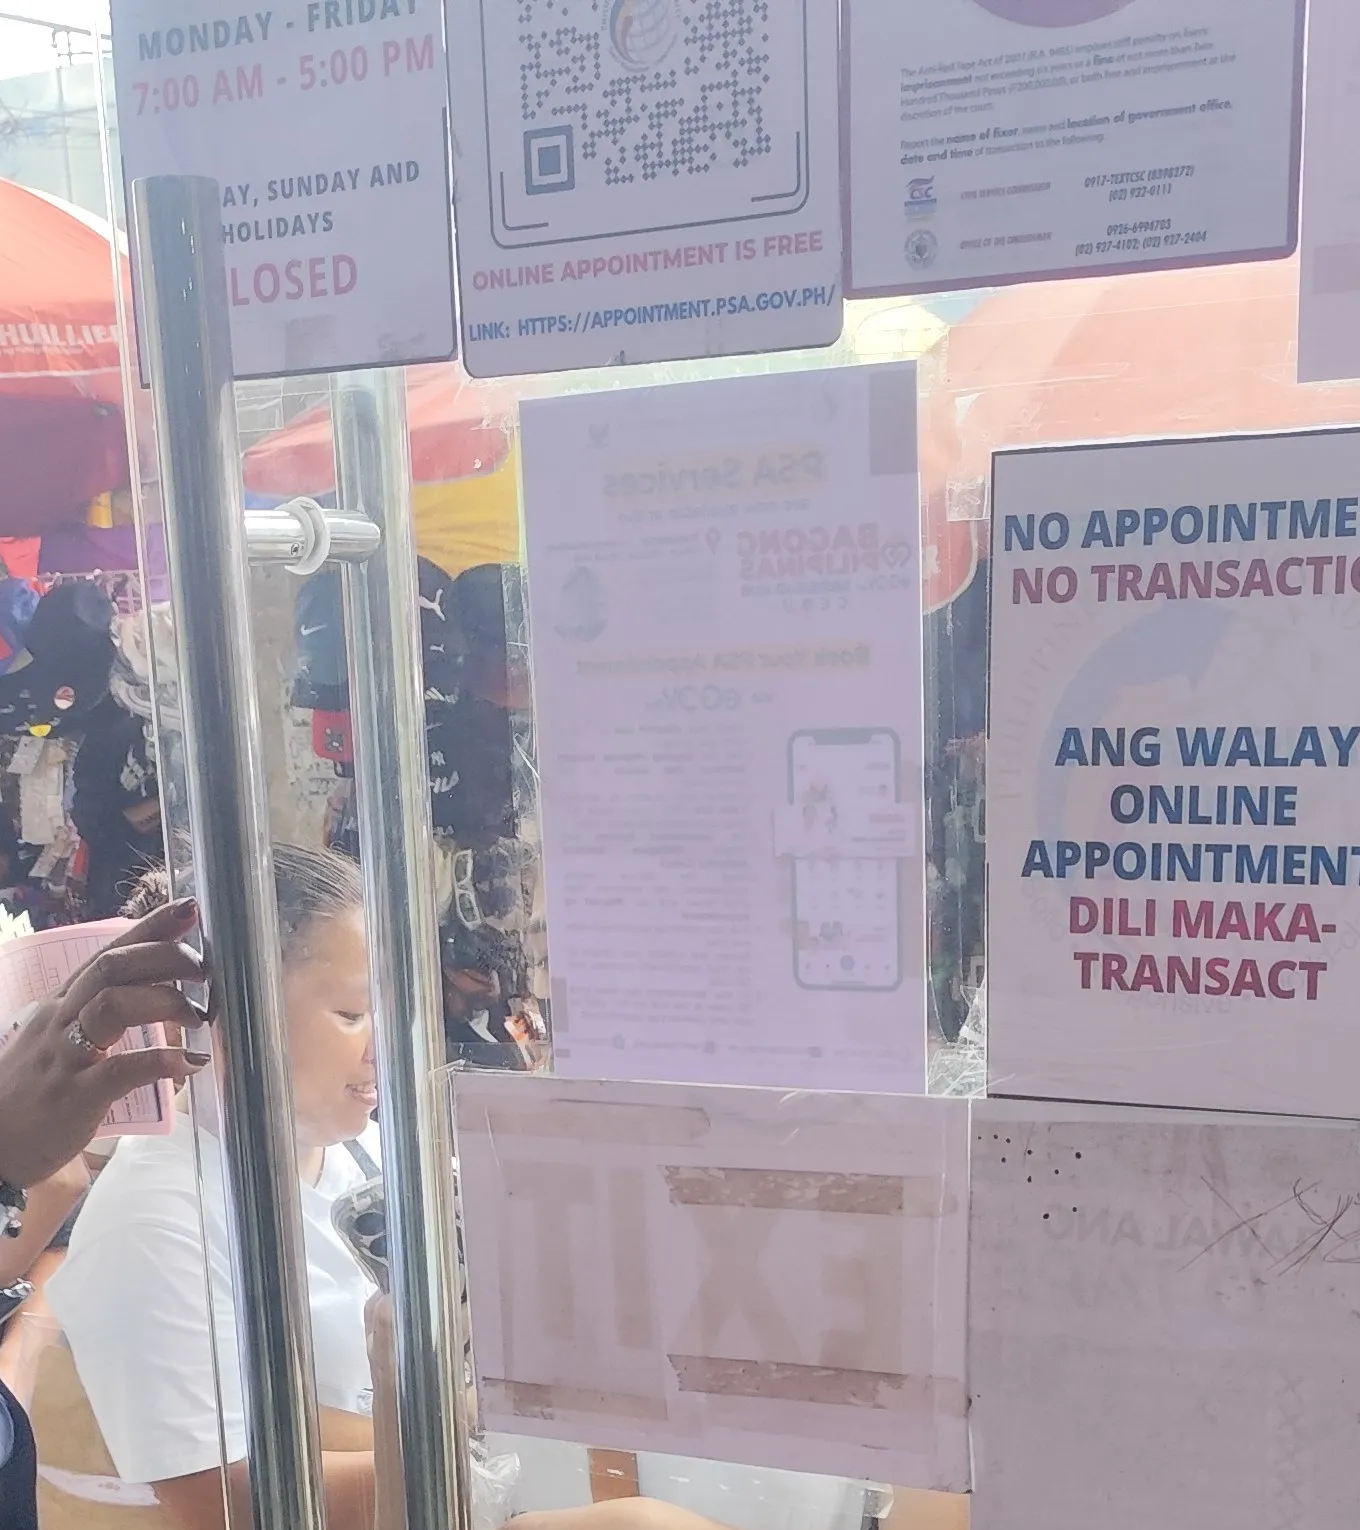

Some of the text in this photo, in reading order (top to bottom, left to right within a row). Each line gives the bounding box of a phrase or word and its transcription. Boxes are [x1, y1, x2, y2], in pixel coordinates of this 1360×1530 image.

[138, 11, 273, 61] MONDAY
[132, 74, 200, 116] 7:00
[212, 63, 264, 105] AM
[299, 45, 368, 91] 5:00
[383, 33, 435, 77] PM
[946, 133, 976, 144] name
[979, 128, 991, 140] of
[1113, 110, 1126, 123] of
[900, 151, 924, 165] date
[927, 149, 948, 162] and
[950, 147, 974, 159] time
[267, 168, 360, 202] SUNDAY
[369, 160, 420, 188] AND
[222, 211, 334, 244] HOLIDAYS
[230, 253, 358, 307] LOSED
[472, 230, 824, 292] ONLINE APPOINTMENT IS FREE
[469, 284, 837, 343] LINK: HTTPS://APPOINTMENT.PSA.GOV.PH/
[1004, 512, 1070, 551] NO
[1012, 566, 1078, 604] NO
[1055, 727, 1161, 767] ANG
[1110, 785, 1298, 826] ONLINE
[1069, 896, 1337, 943] DILI MAKA-
[1073, 952, 1328, 1001] TRANSACT
